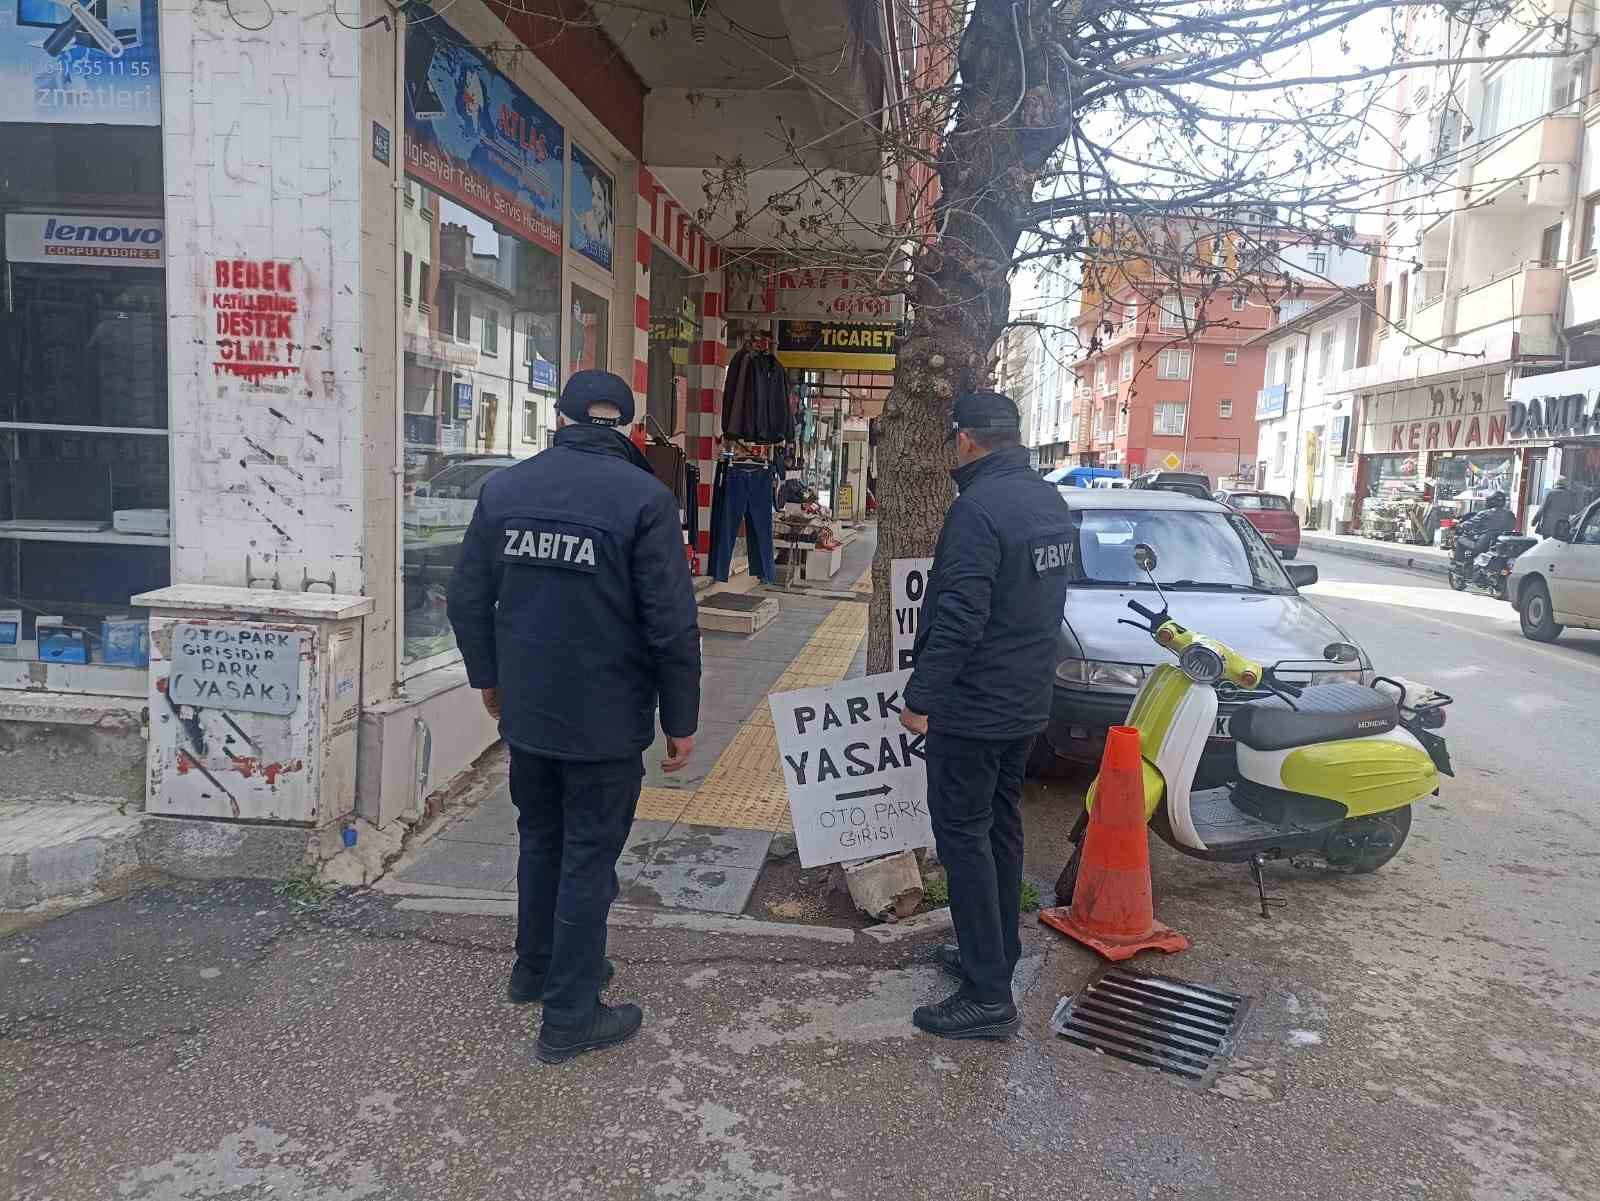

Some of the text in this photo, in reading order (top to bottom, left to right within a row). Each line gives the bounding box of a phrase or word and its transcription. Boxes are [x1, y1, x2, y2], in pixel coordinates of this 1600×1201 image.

[109, 61, 124, 76] 11
[130, 61, 151, 77] 55
[404, 134, 456, 183] ilgisayar
[44, 218, 163, 244] lenovo
[215, 260, 292, 291] BEBEK
[1391, 414, 1508, 451] KERVAN
[503, 529, 596, 566] ZABITA
[202, 658, 259, 679] PARK
[793, 690, 901, 735] PARK
[784, 733, 926, 785] YASAK
[819, 799, 928, 829] OTO PARK
